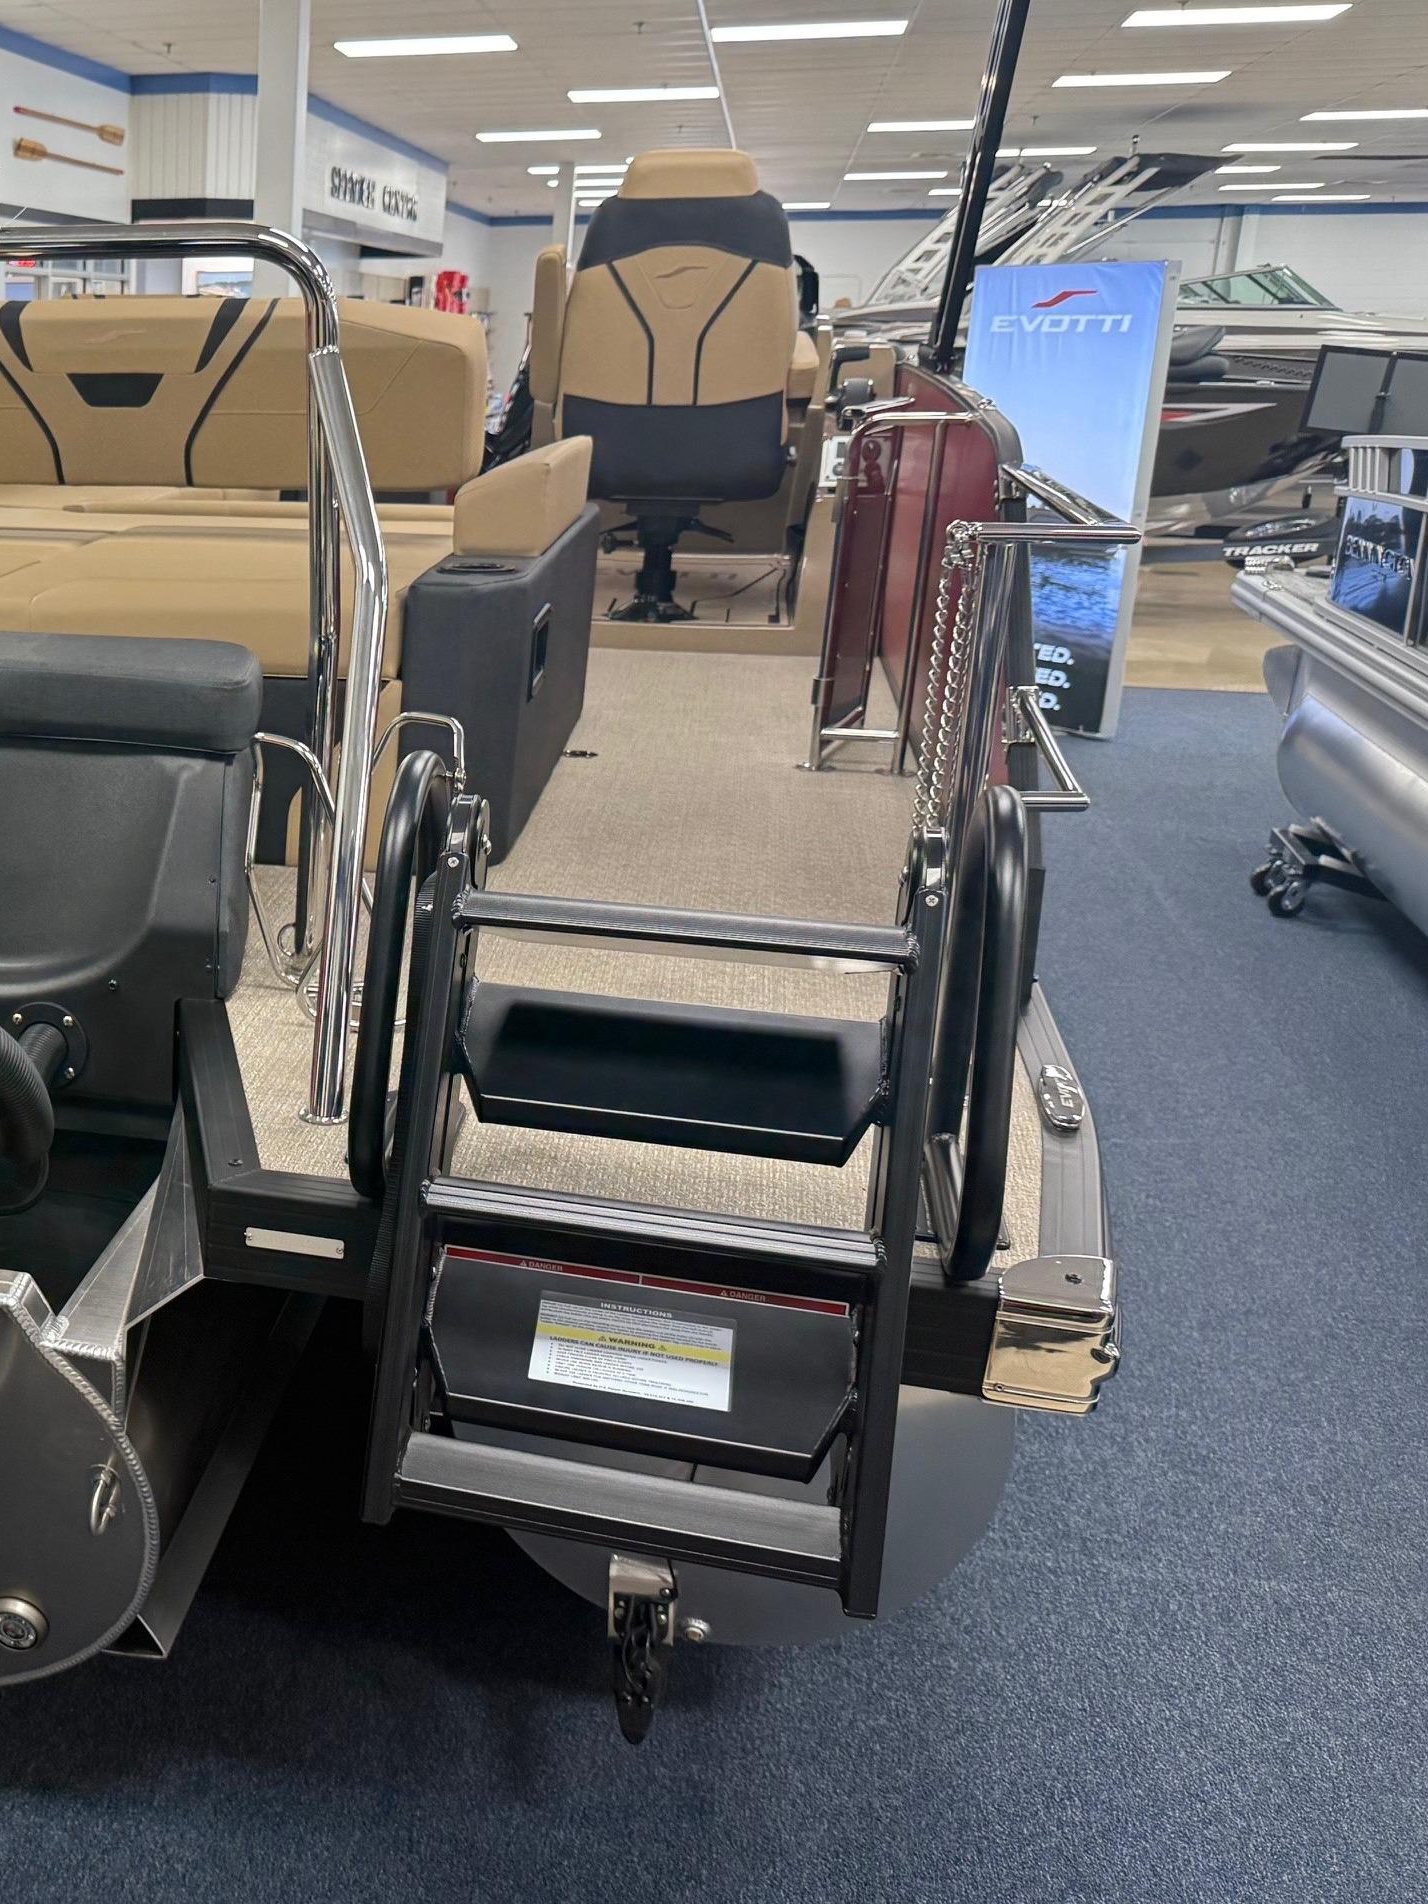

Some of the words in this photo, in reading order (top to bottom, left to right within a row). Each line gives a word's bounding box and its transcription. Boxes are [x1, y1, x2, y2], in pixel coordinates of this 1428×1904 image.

[990, 314, 1132, 333] EVOTTI
[1222, 543, 1319, 557] TRACKER
[529, 1261, 563, 1271] DANGER
[730, 1291, 766, 1303] DANGER
[600, 1302, 673, 1318] INSTRUCTIONS
[608, 1336, 656, 1349] WARNING
[549, 1336, 579, 1346] LADDERS
[580, 1340, 594, 1348] CAN
[595, 1342, 616, 1351] CAUSE
[617, 1345, 641, 1356] INJURY
[685, 1357, 718, 1367] PROPERLY
